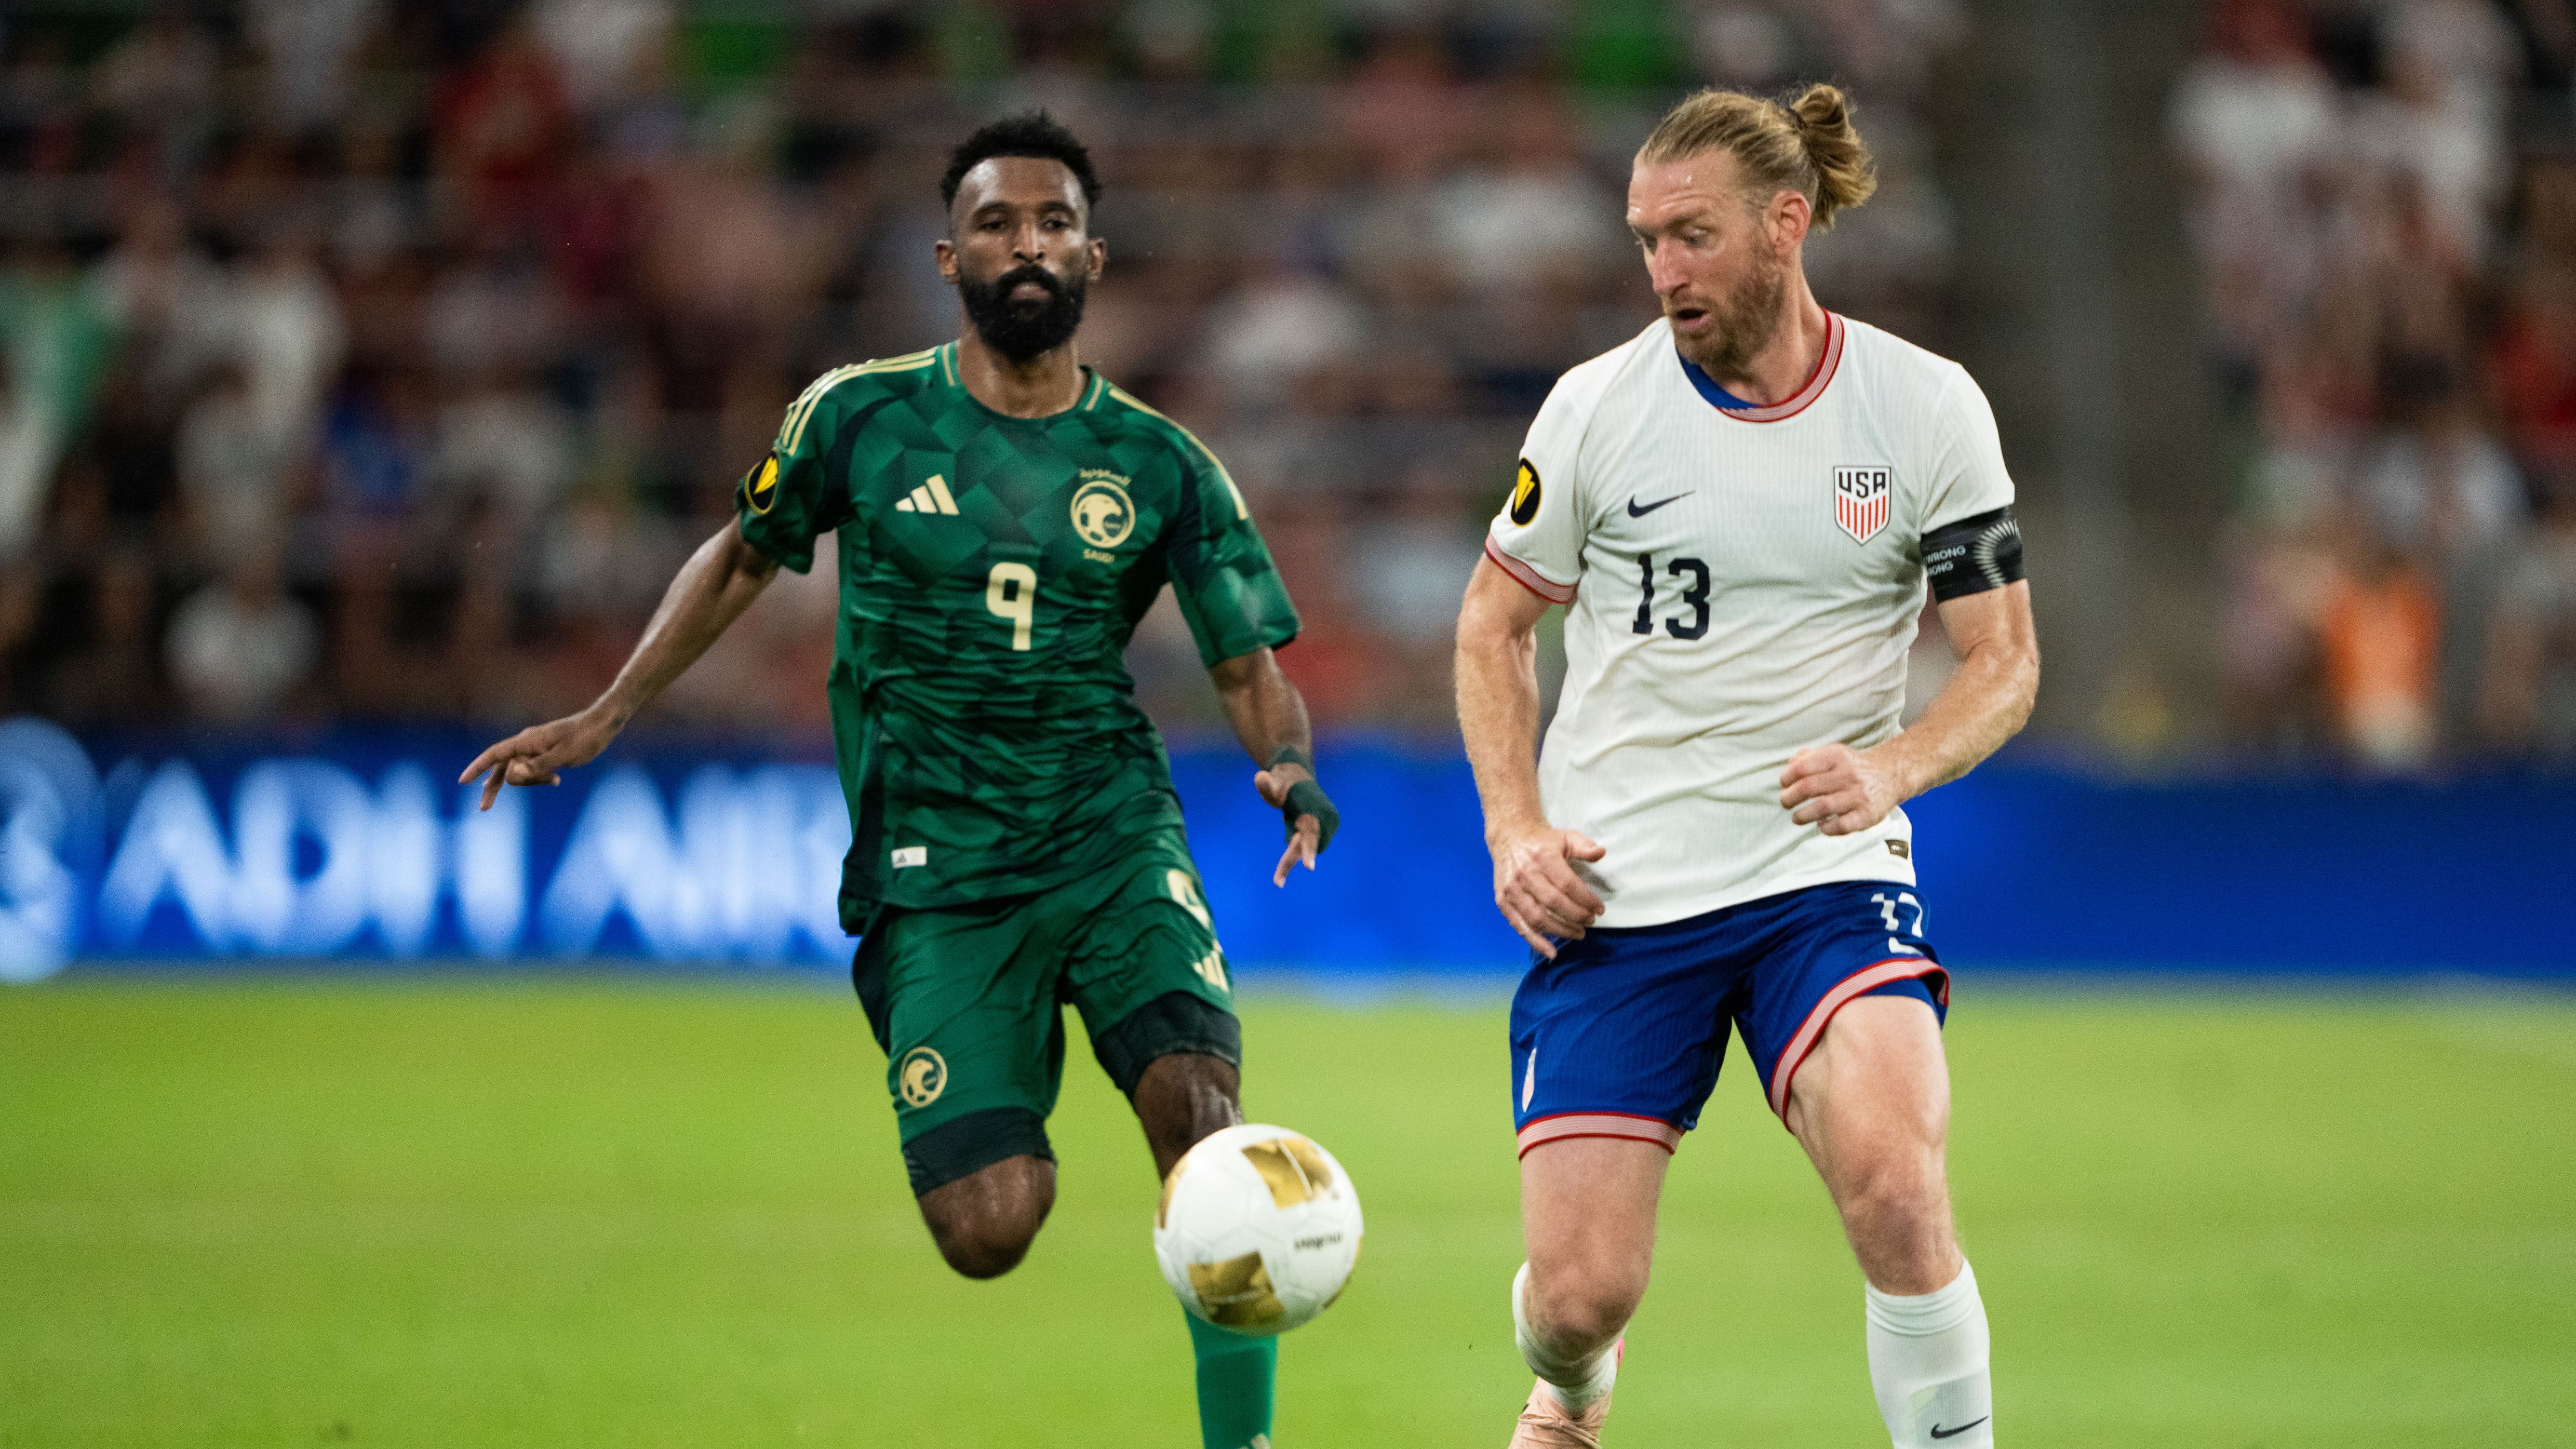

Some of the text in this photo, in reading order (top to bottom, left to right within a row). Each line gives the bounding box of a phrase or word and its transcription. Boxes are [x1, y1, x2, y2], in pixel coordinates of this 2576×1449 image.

[1839, 472, 1886, 498] USA
[986, 562, 1037, 651] 9
[1633, 554, 1710, 640] 13
